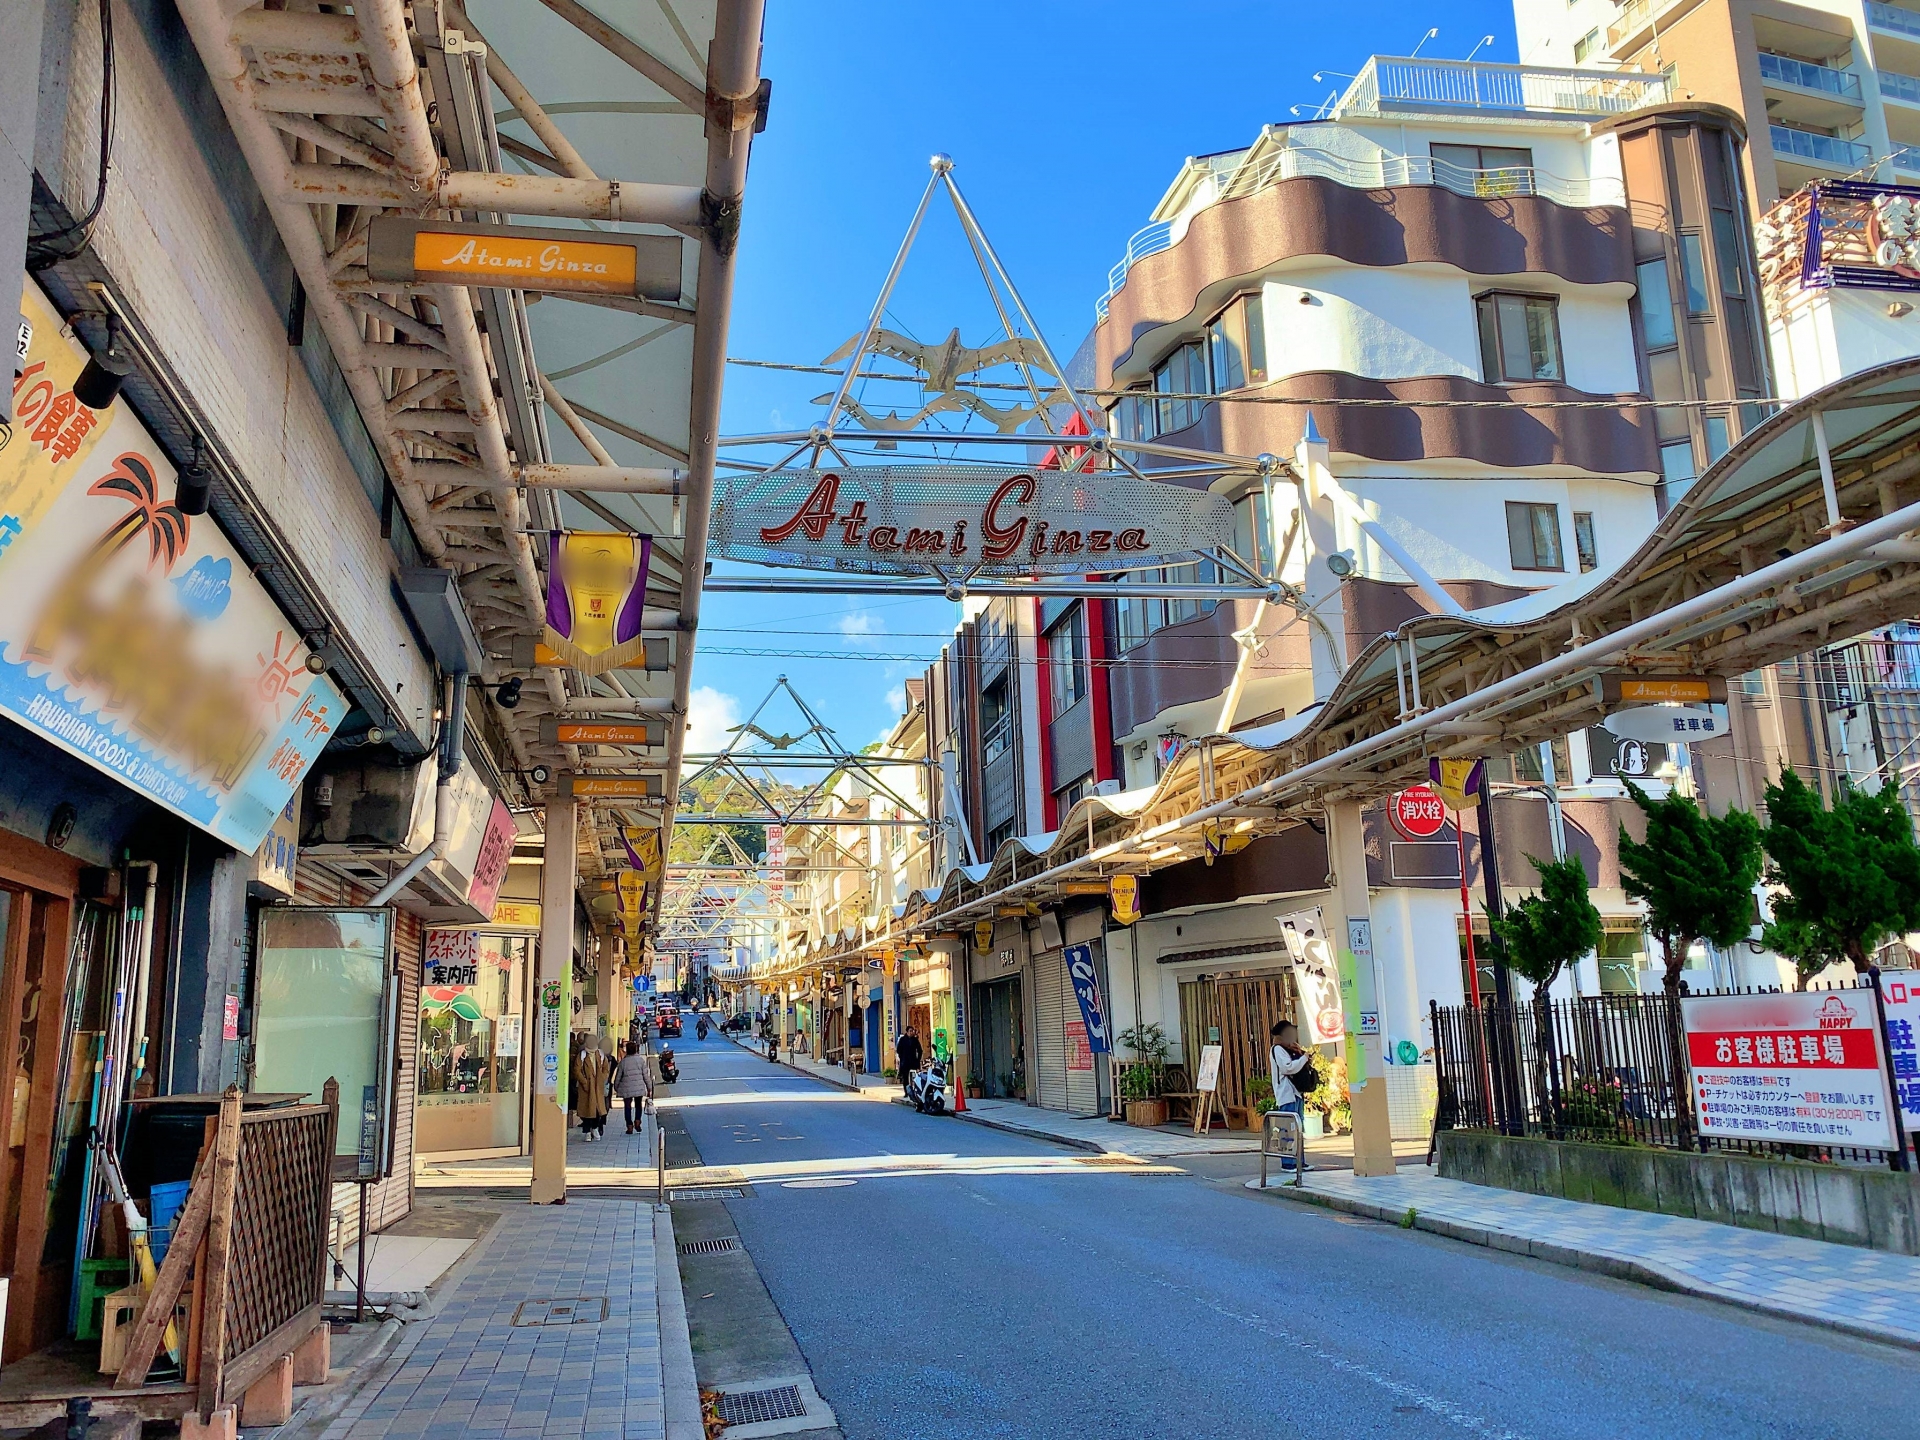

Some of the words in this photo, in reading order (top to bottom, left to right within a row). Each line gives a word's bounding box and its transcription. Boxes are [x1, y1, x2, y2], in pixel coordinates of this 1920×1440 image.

[442, 240, 532, 268] Atami
[538, 245, 608, 275] Ginza
[760, 472, 968, 557] Atami
[981, 475, 1151, 560] Ginza
[1632, 684, 1668, 696] Atami
[1669, 683, 1698, 697] Ginza
[1672, 717, 1715, 732] 駐車場
[568, 727, 605, 739] Atami
[607, 727, 635, 740] Ginza
[25, 693, 97, 750] HAWAIIAN
[88, 733, 132, 771] FOODS
[126, 756, 140, 777] &
[134, 761, 169, 796] DARTS
[162, 779, 189, 806] PLAY
[582, 782, 613, 792] Atami
[614, 782, 638, 793] Ginza
[1401, 800, 1442, 820] 消火栓
[438, 931, 472, 946] ナイト
[428, 943, 476, 960] スポット
[431, 964, 478, 985] 案内所
[1819, 1017, 1853, 1029] HAPPY
[1715, 1034, 1846, 1065] お客様駐車場
